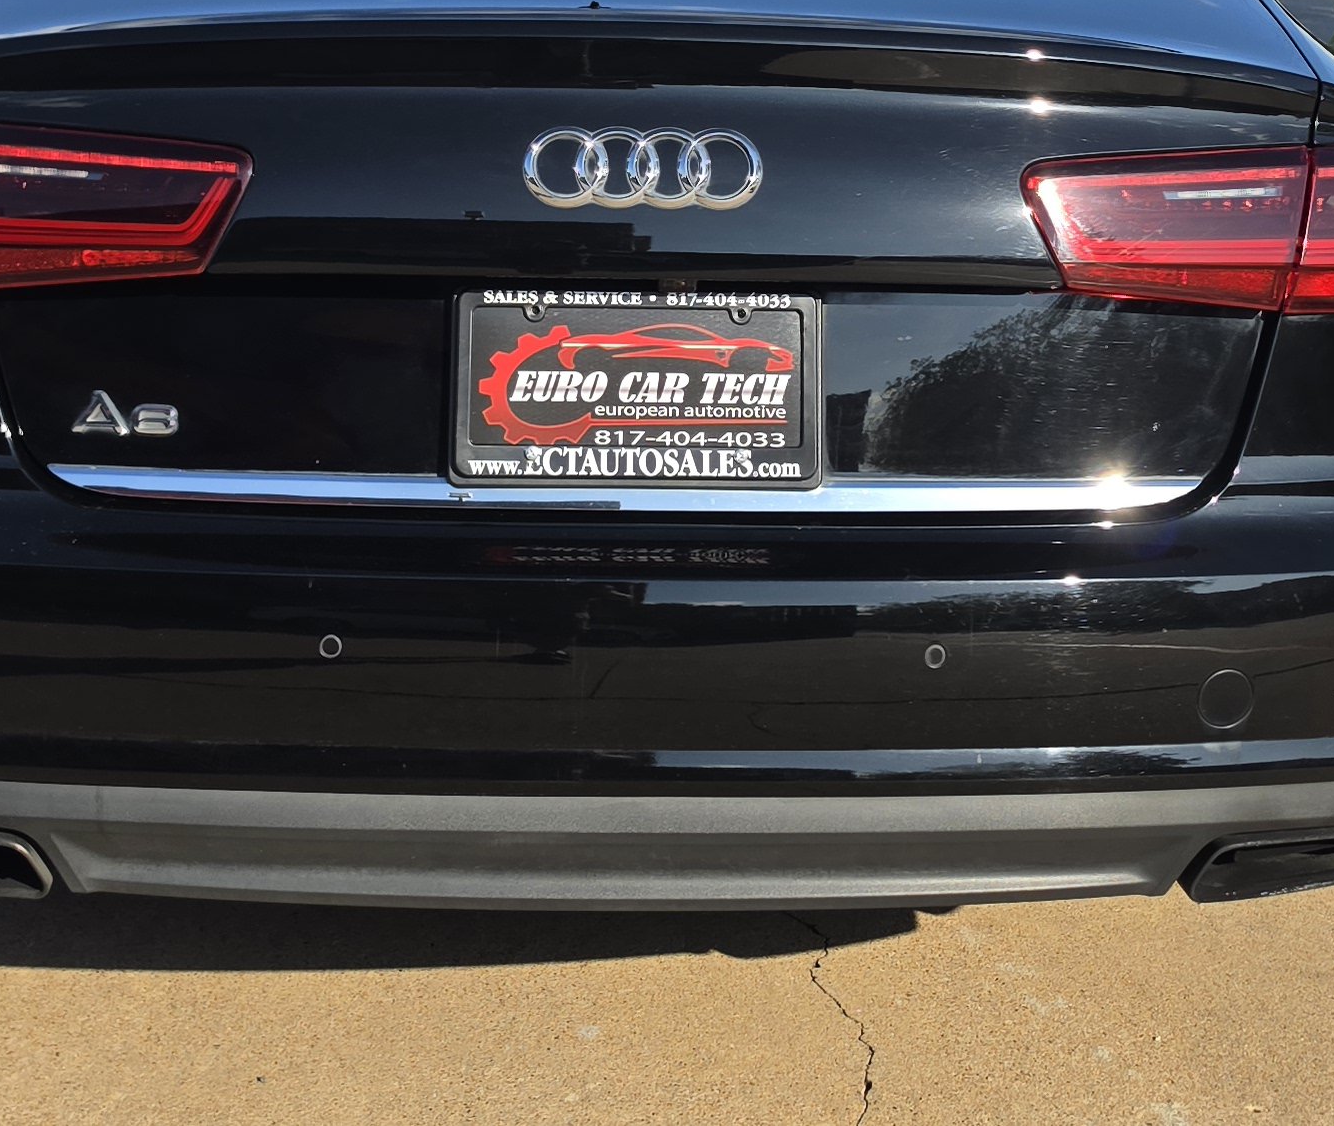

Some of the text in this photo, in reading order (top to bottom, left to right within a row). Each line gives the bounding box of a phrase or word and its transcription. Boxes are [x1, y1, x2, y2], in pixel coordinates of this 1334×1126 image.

[483, 290, 792, 308] SALES & SERVICE 817-404-4033
[509, 370, 792, 406] EURO CAR TECH
[71, 389, 179, 436] A6
[594, 404, 787, 419] european automotive
[593, 430, 786, 448] 817-404-4033
[467, 447, 802, 479] www.ECTAUTOSALES.com
